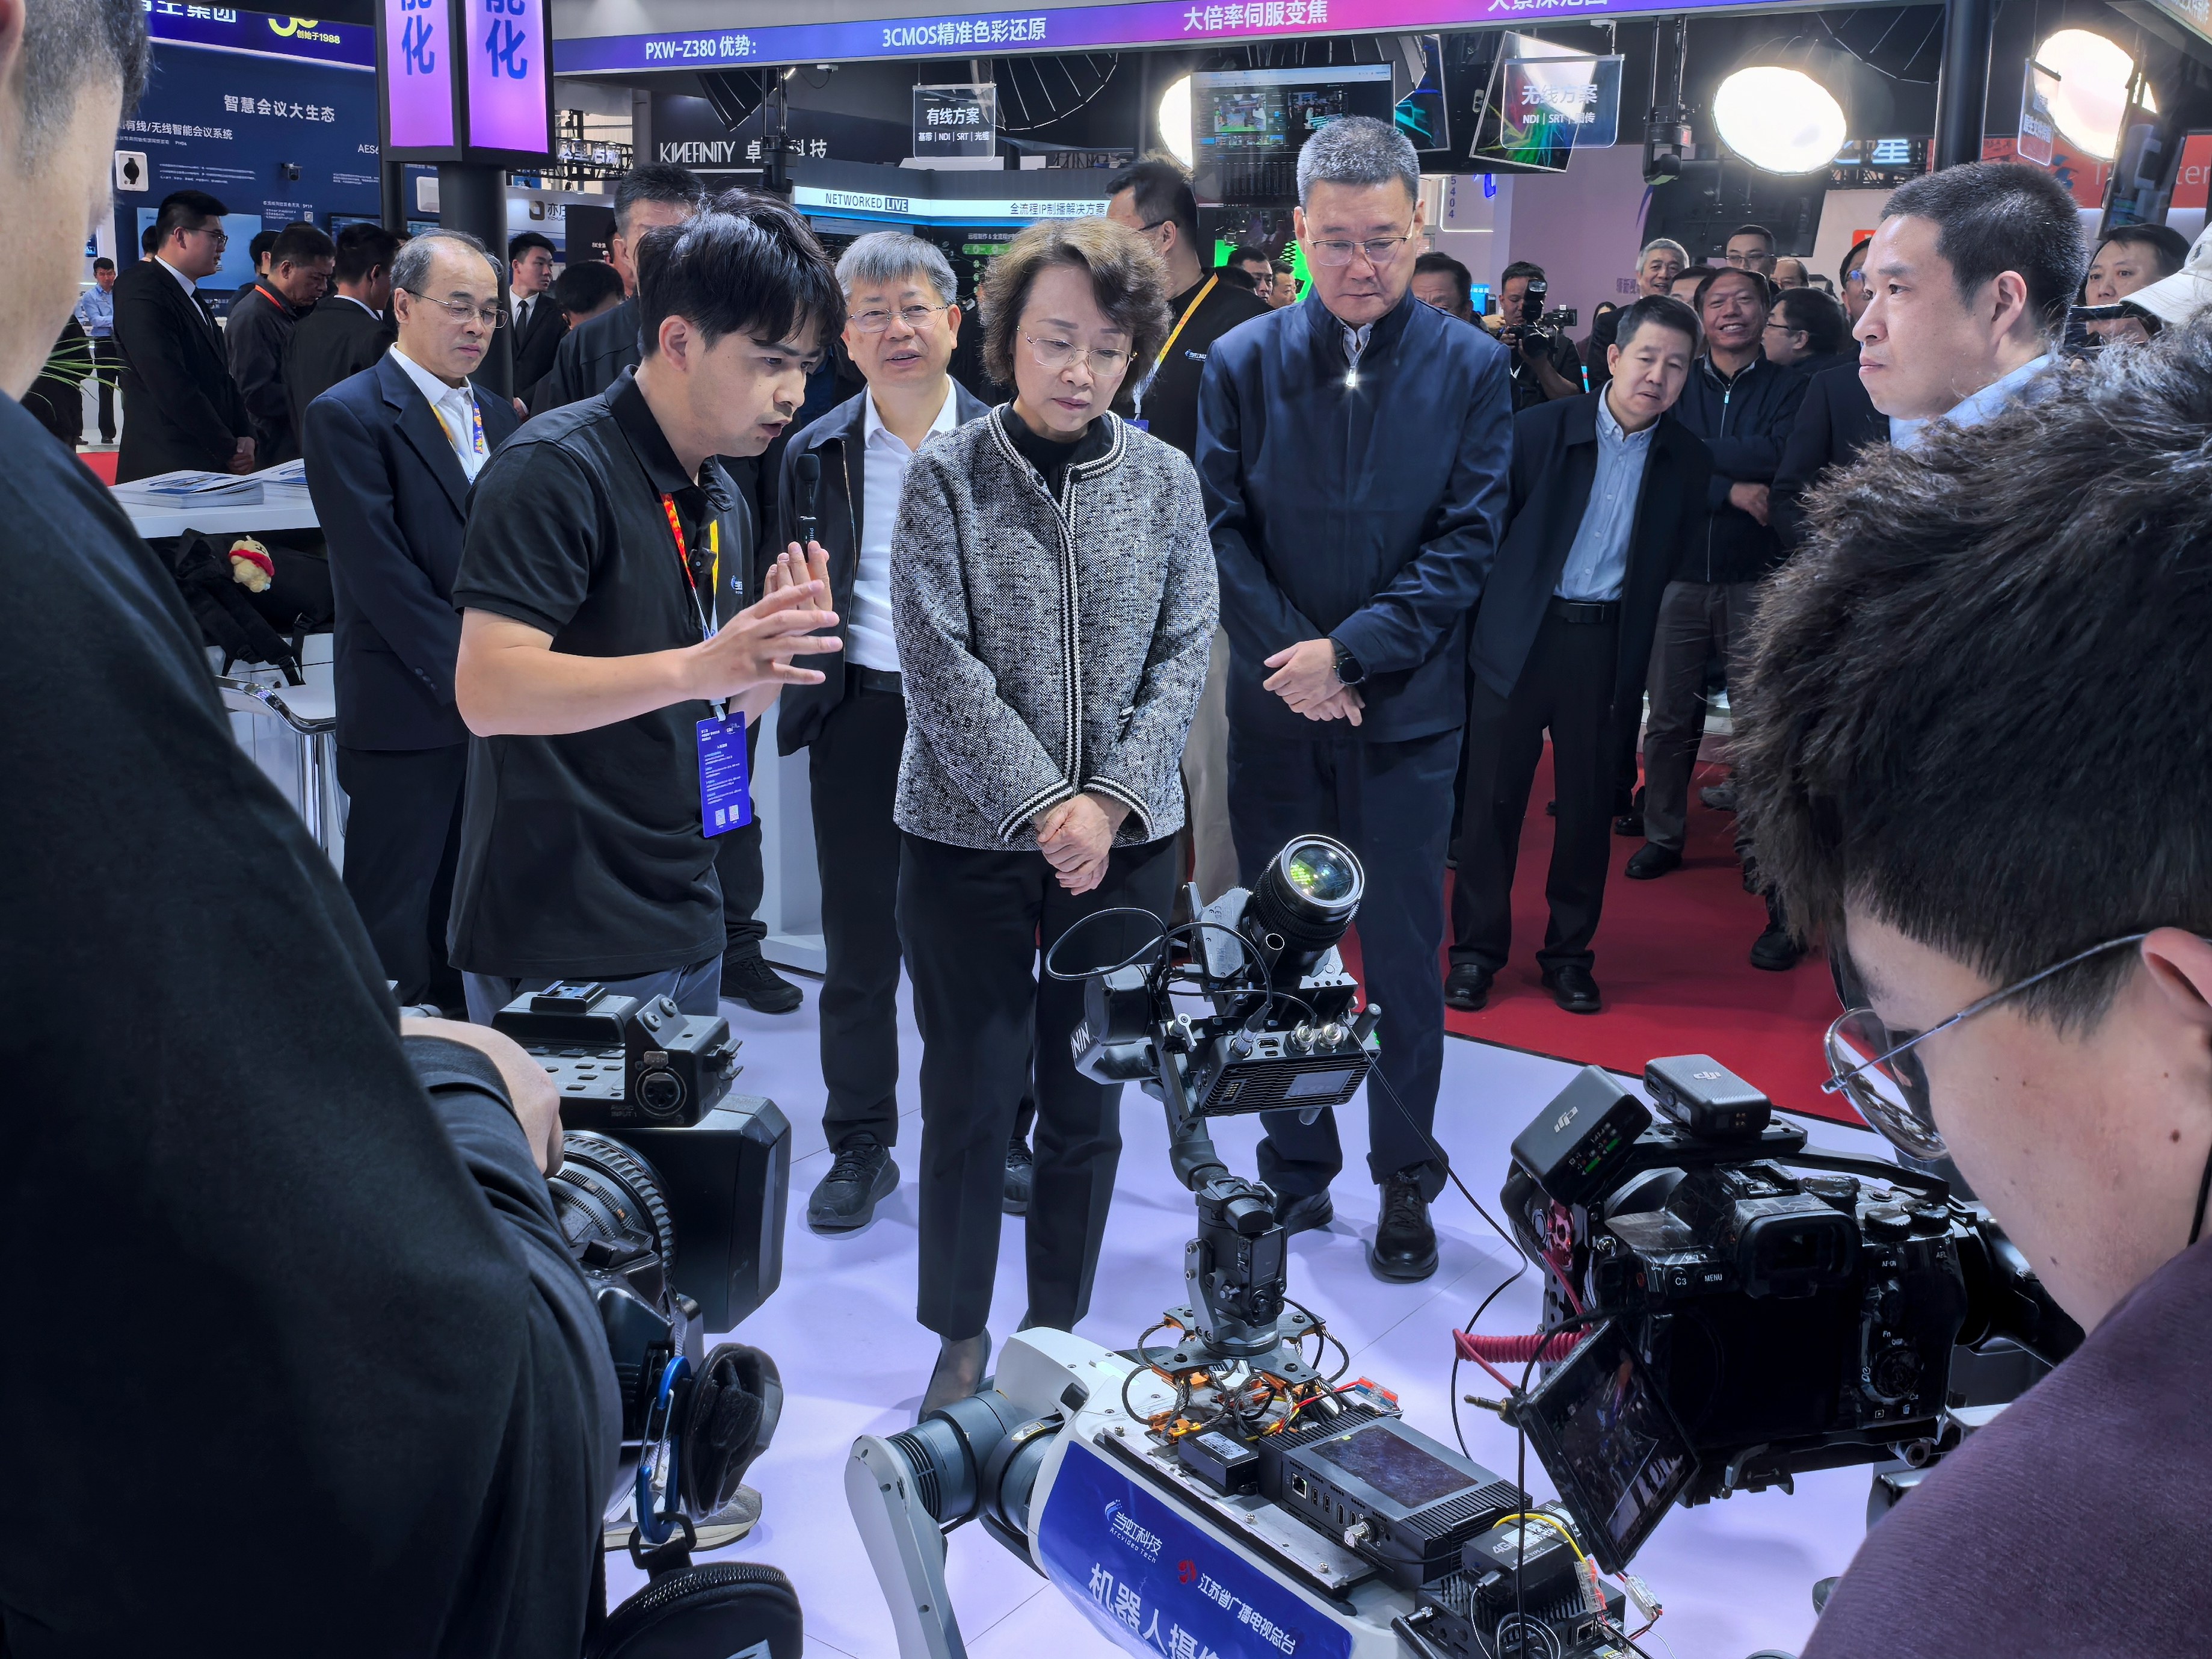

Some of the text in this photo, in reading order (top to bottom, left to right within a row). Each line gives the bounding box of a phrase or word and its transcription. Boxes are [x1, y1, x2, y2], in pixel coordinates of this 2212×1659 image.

[1183, 1, 1328, 31] 大倍率伺服变焦
[297, 29, 340, 44] 创始于1988
[401, 0, 435, 75] 化
[485, 0, 528, 79] 化
[883, 17, 1046, 48] 3CMOS精准色彩还原
[645, 39, 716, 60] PXW-Z380
[1521, 84, 1597, 105] 无线方案
[224, 94, 335, 122] 智慧会议大生态
[926, 108, 979, 125] 有线方案
[1523, 114, 1539, 124] NDI
[1548, 113, 1563, 123] SRT
[919, 132, 932, 141] 基带
[825, 193, 908, 211] NETWORKED LIVE
[1010, 203, 1105, 215] 全流程IP制播解决方案
[1675, 1273, 1722, 1286] C3 MENU
[1113, 1512, 1162, 1556] 当虹科技
[1140, 1548, 1156, 1563] Tech
[1198, 1573, 1296, 1655] 江苏省广播电视总台
